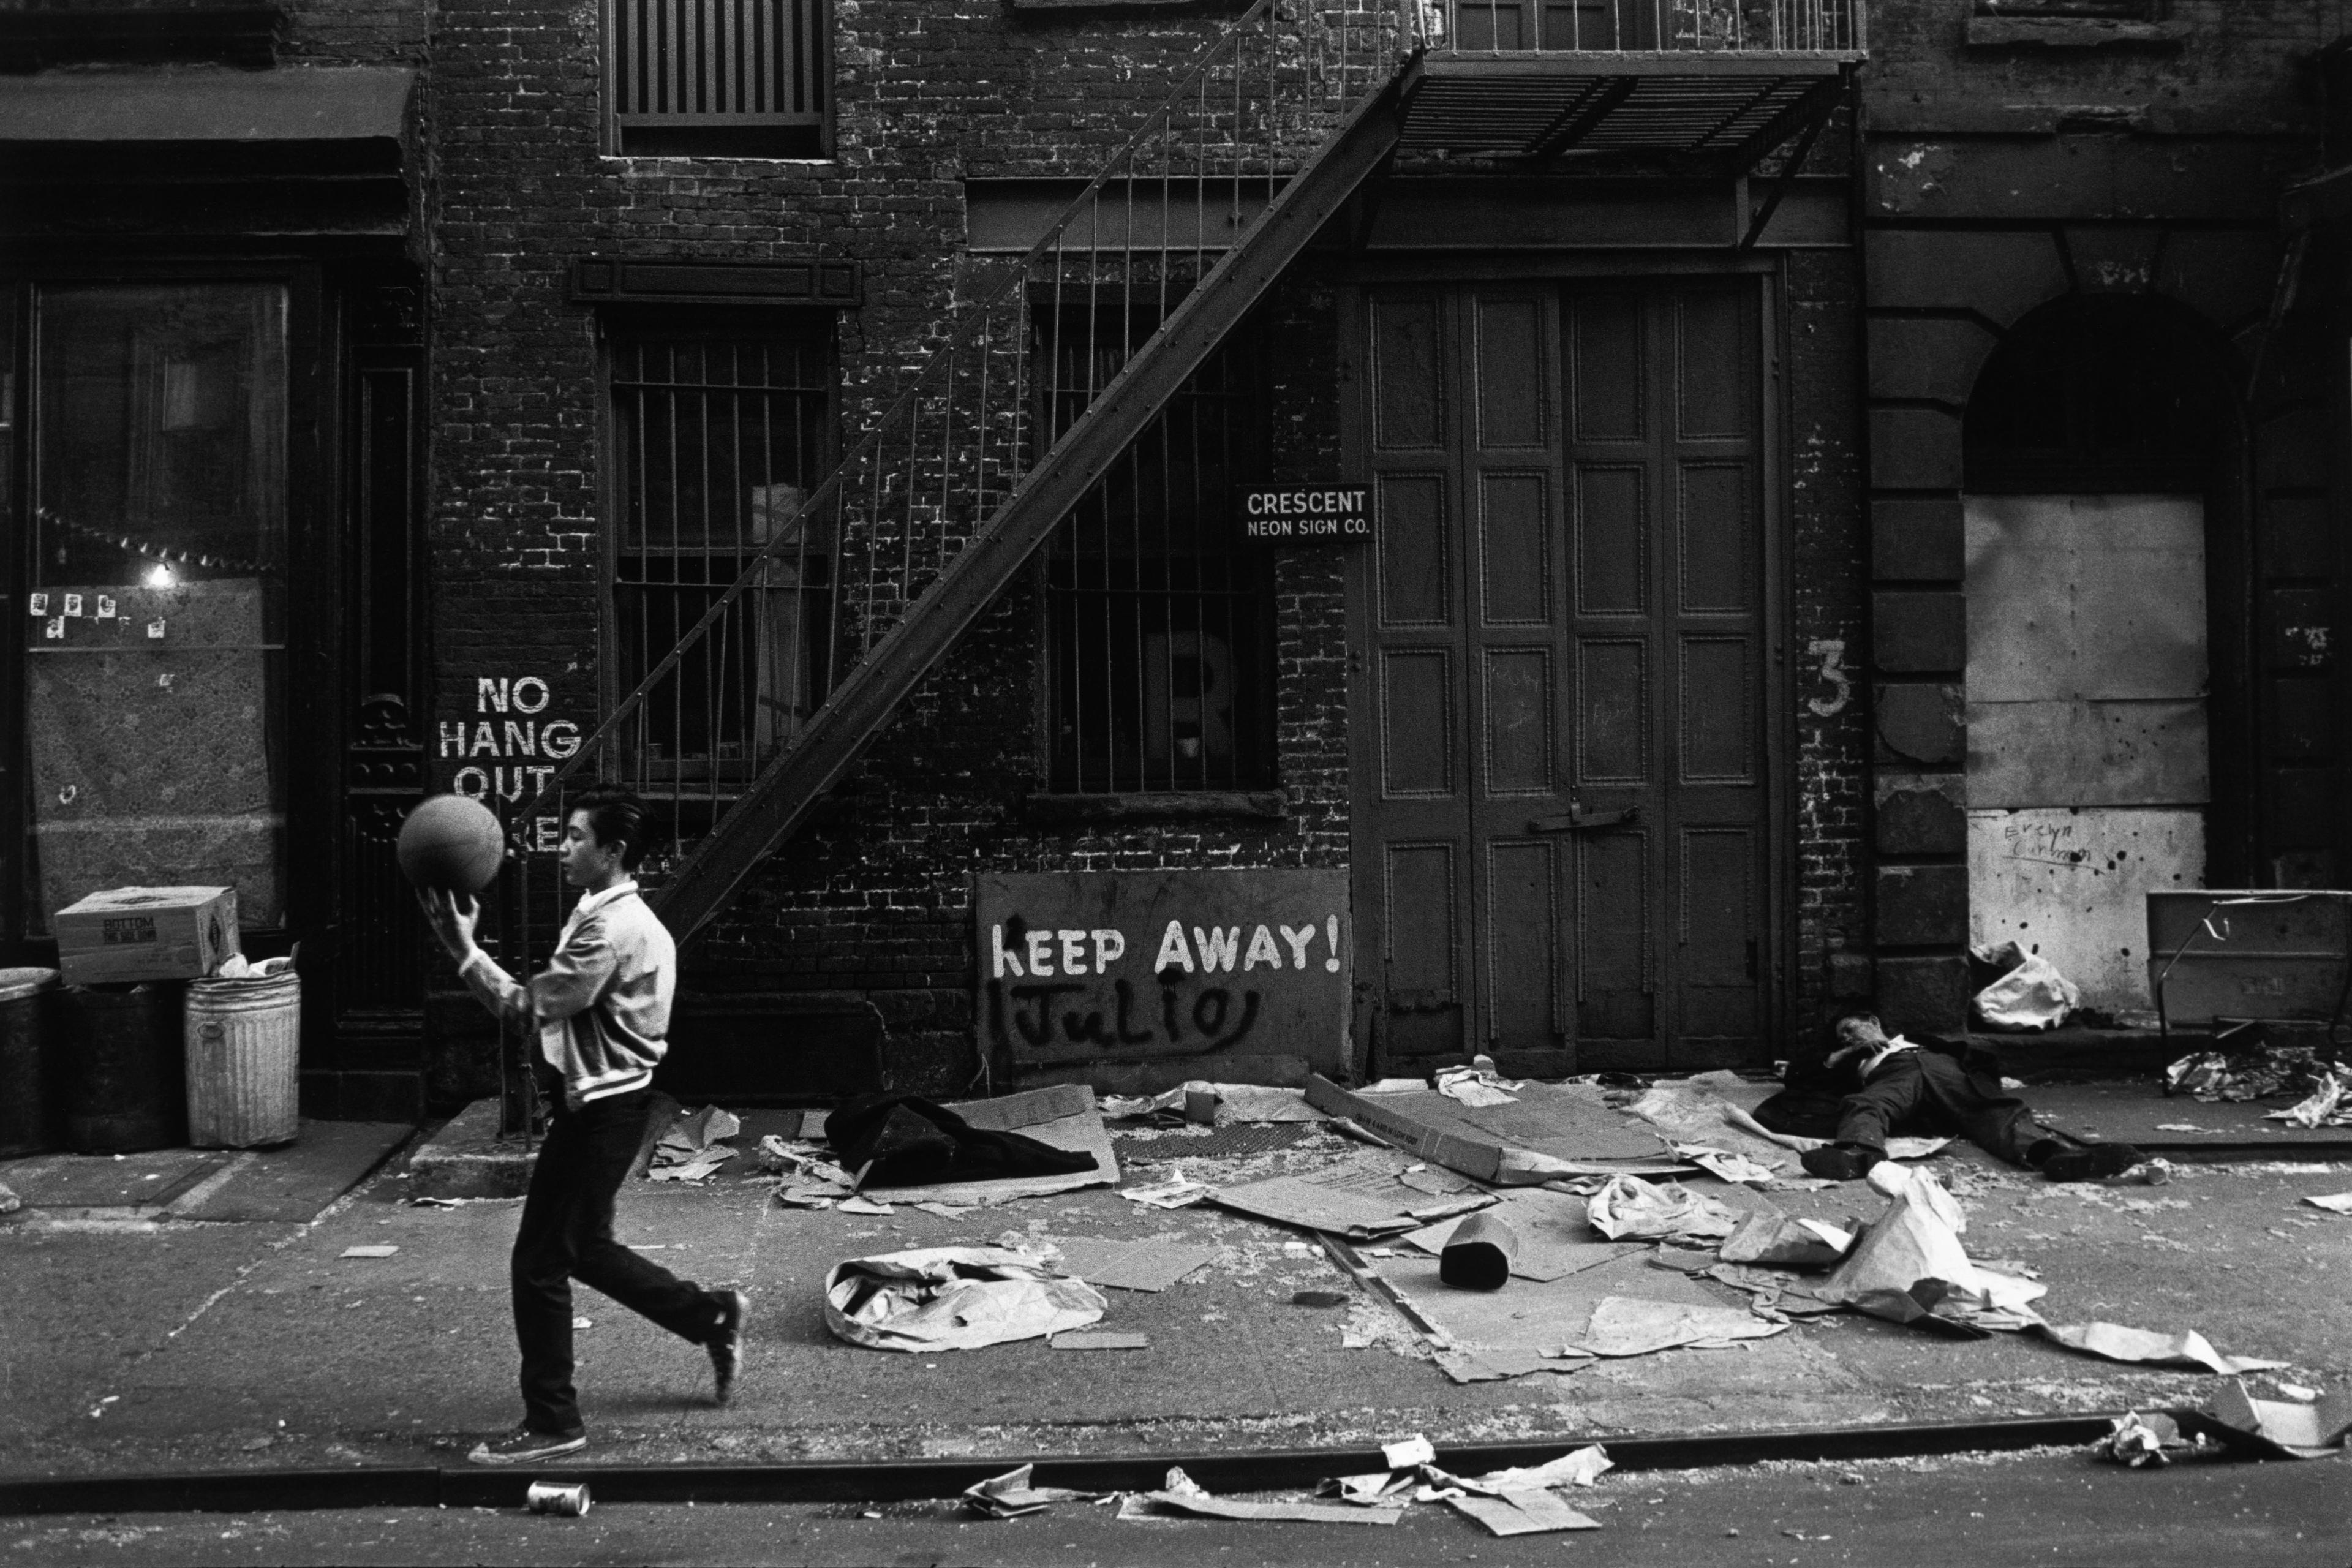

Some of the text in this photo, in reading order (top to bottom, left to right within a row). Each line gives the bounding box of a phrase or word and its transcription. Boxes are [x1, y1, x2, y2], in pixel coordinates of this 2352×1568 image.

[1248, 492, 1365, 514] CRESCENT
[1248, 519, 1370, 536] NEON SIGN CO.
[478, 676, 549, 714] NO
[1808, 640, 1850, 717] 3
[440, 720, 581, 759] HANG
[454, 766, 554, 802] OUT
[104, 917, 154, 930] BOTTOM
[992, 914, 1340, 978] KEEP AWAY!
